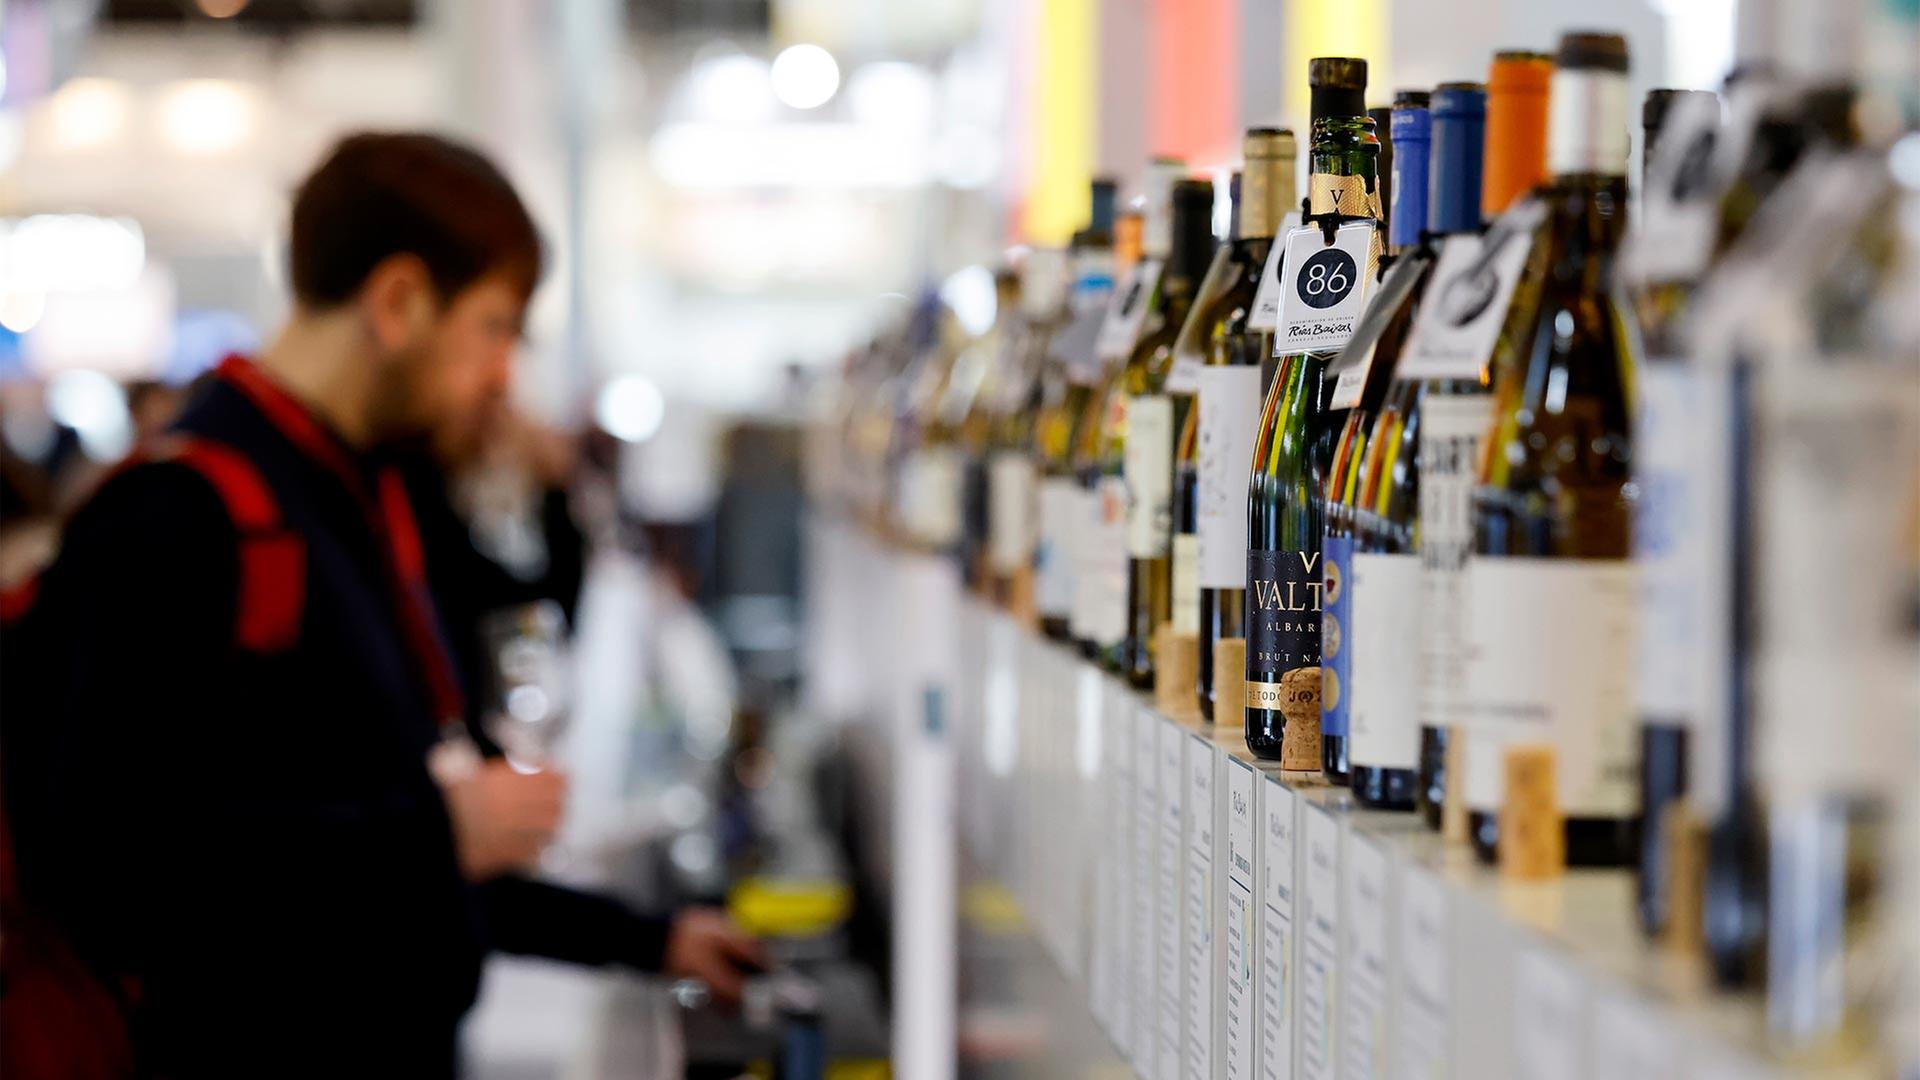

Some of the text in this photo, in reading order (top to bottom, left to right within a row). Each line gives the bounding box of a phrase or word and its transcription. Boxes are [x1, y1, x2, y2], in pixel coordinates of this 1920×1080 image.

[1330, 189, 1345, 205] V
[1306, 262, 1347, 295] 86
[1312, 322, 1353, 336] Baixas
[1299, 551, 1320, 574] V
[1254, 580, 1323, 612] VALT
[1258, 651, 1290, 662] BRUT
